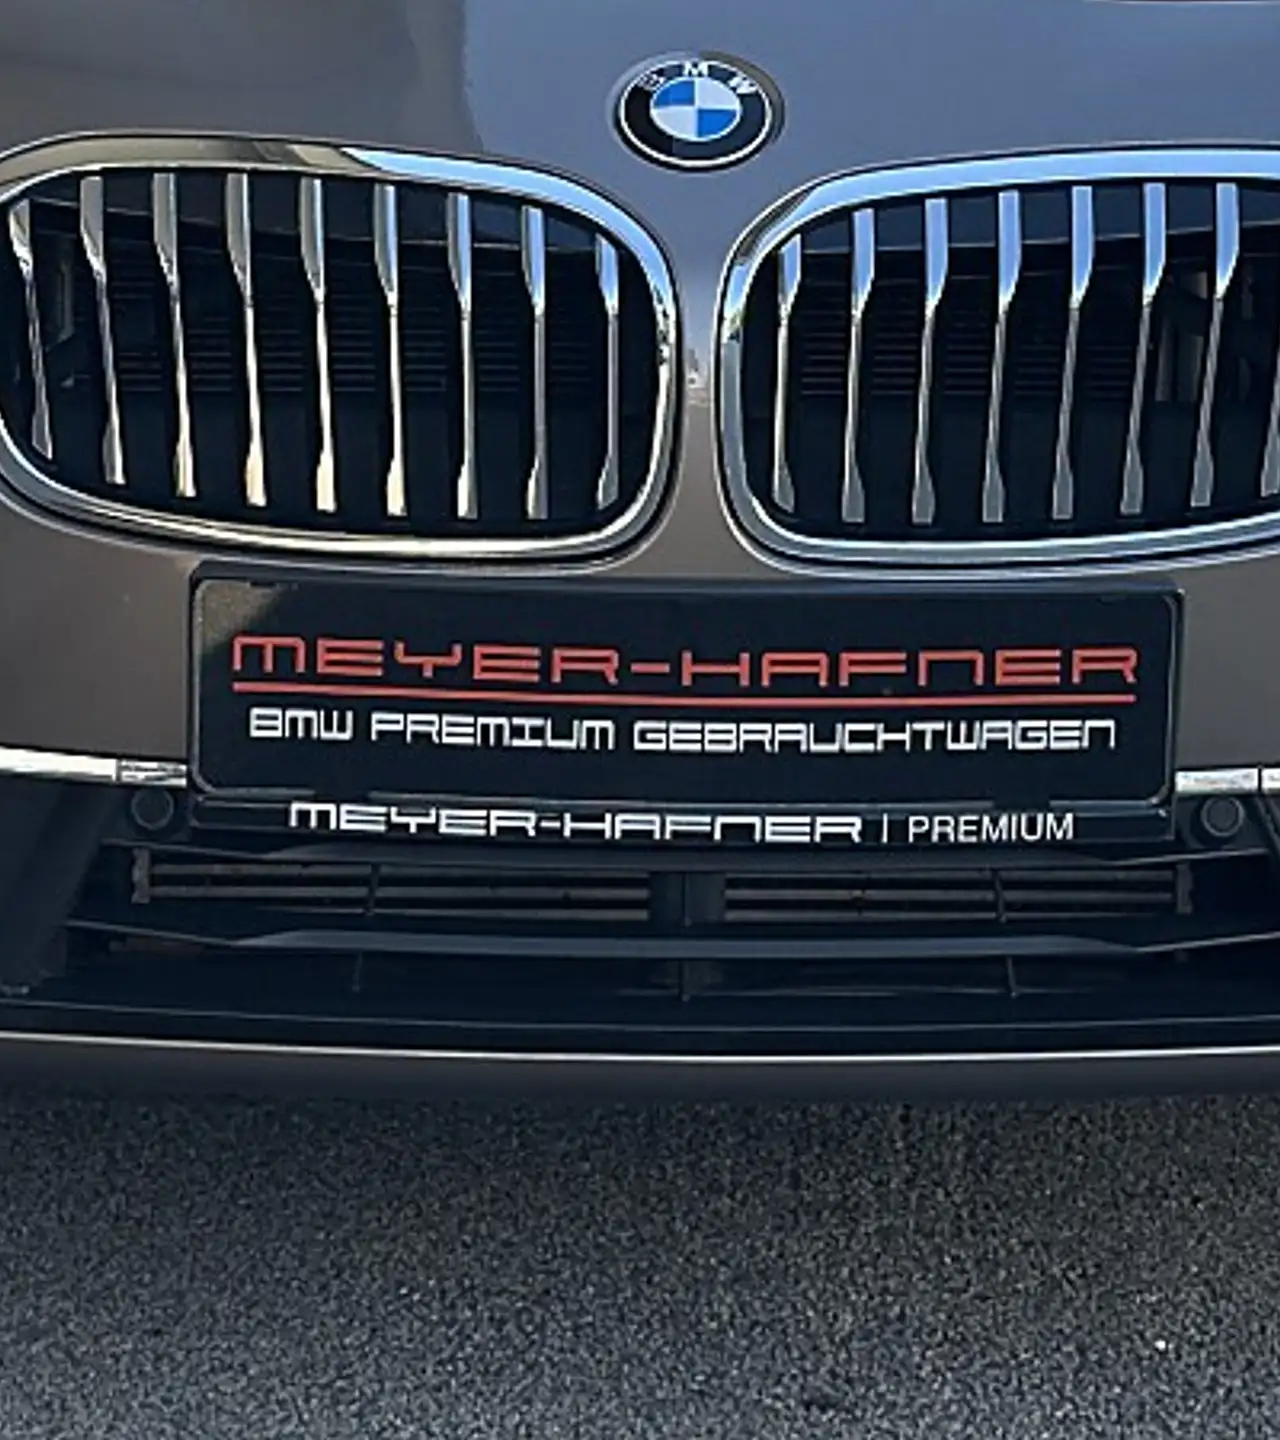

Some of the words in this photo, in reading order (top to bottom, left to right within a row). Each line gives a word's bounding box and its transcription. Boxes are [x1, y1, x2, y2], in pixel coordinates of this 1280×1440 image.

[638, 59, 758, 94] BMW
[232, 635, 1138, 687] MEYER-HAFNER
[249, 707, 354, 741] BMW
[370, 711, 616, 751] PREMIUM
[632, 718, 1117, 754] GEBRAUCHTWAGEN
[288, 801, 863, 844] MEYER-HAFNER
[907, 812, 1075, 844] PREMIUM
